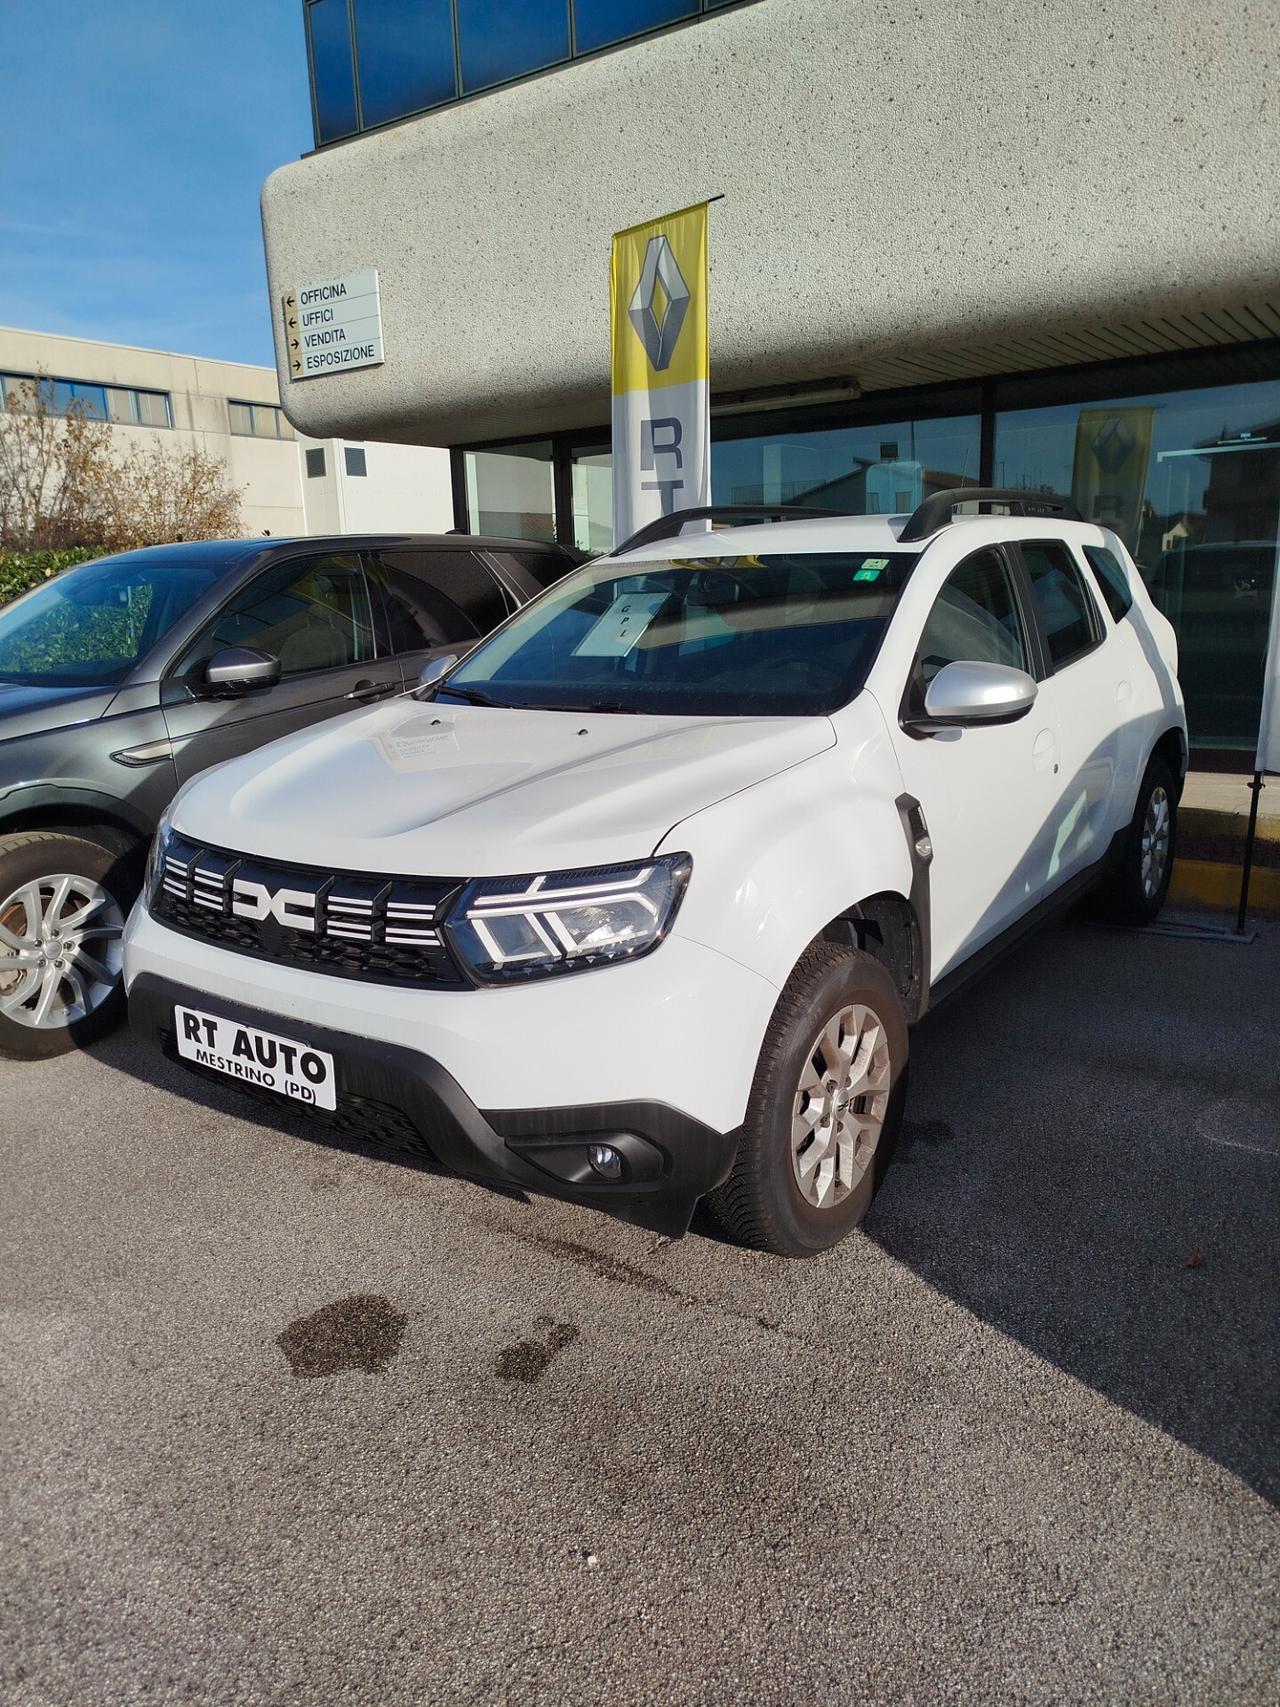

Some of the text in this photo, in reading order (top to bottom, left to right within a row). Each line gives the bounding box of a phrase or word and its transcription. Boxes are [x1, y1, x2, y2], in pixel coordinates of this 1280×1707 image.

[300, 283, 347, 305] OFFICINA
[302, 308, 334, 327] UFFICI
[304, 328, 346, 348] VENDITA
[306, 344, 375, 369] ESPOSIZIONE
[182, 1011, 327, 1085] RT AUTO
[196, 1049, 317, 1106] MESTRINO (PD)
